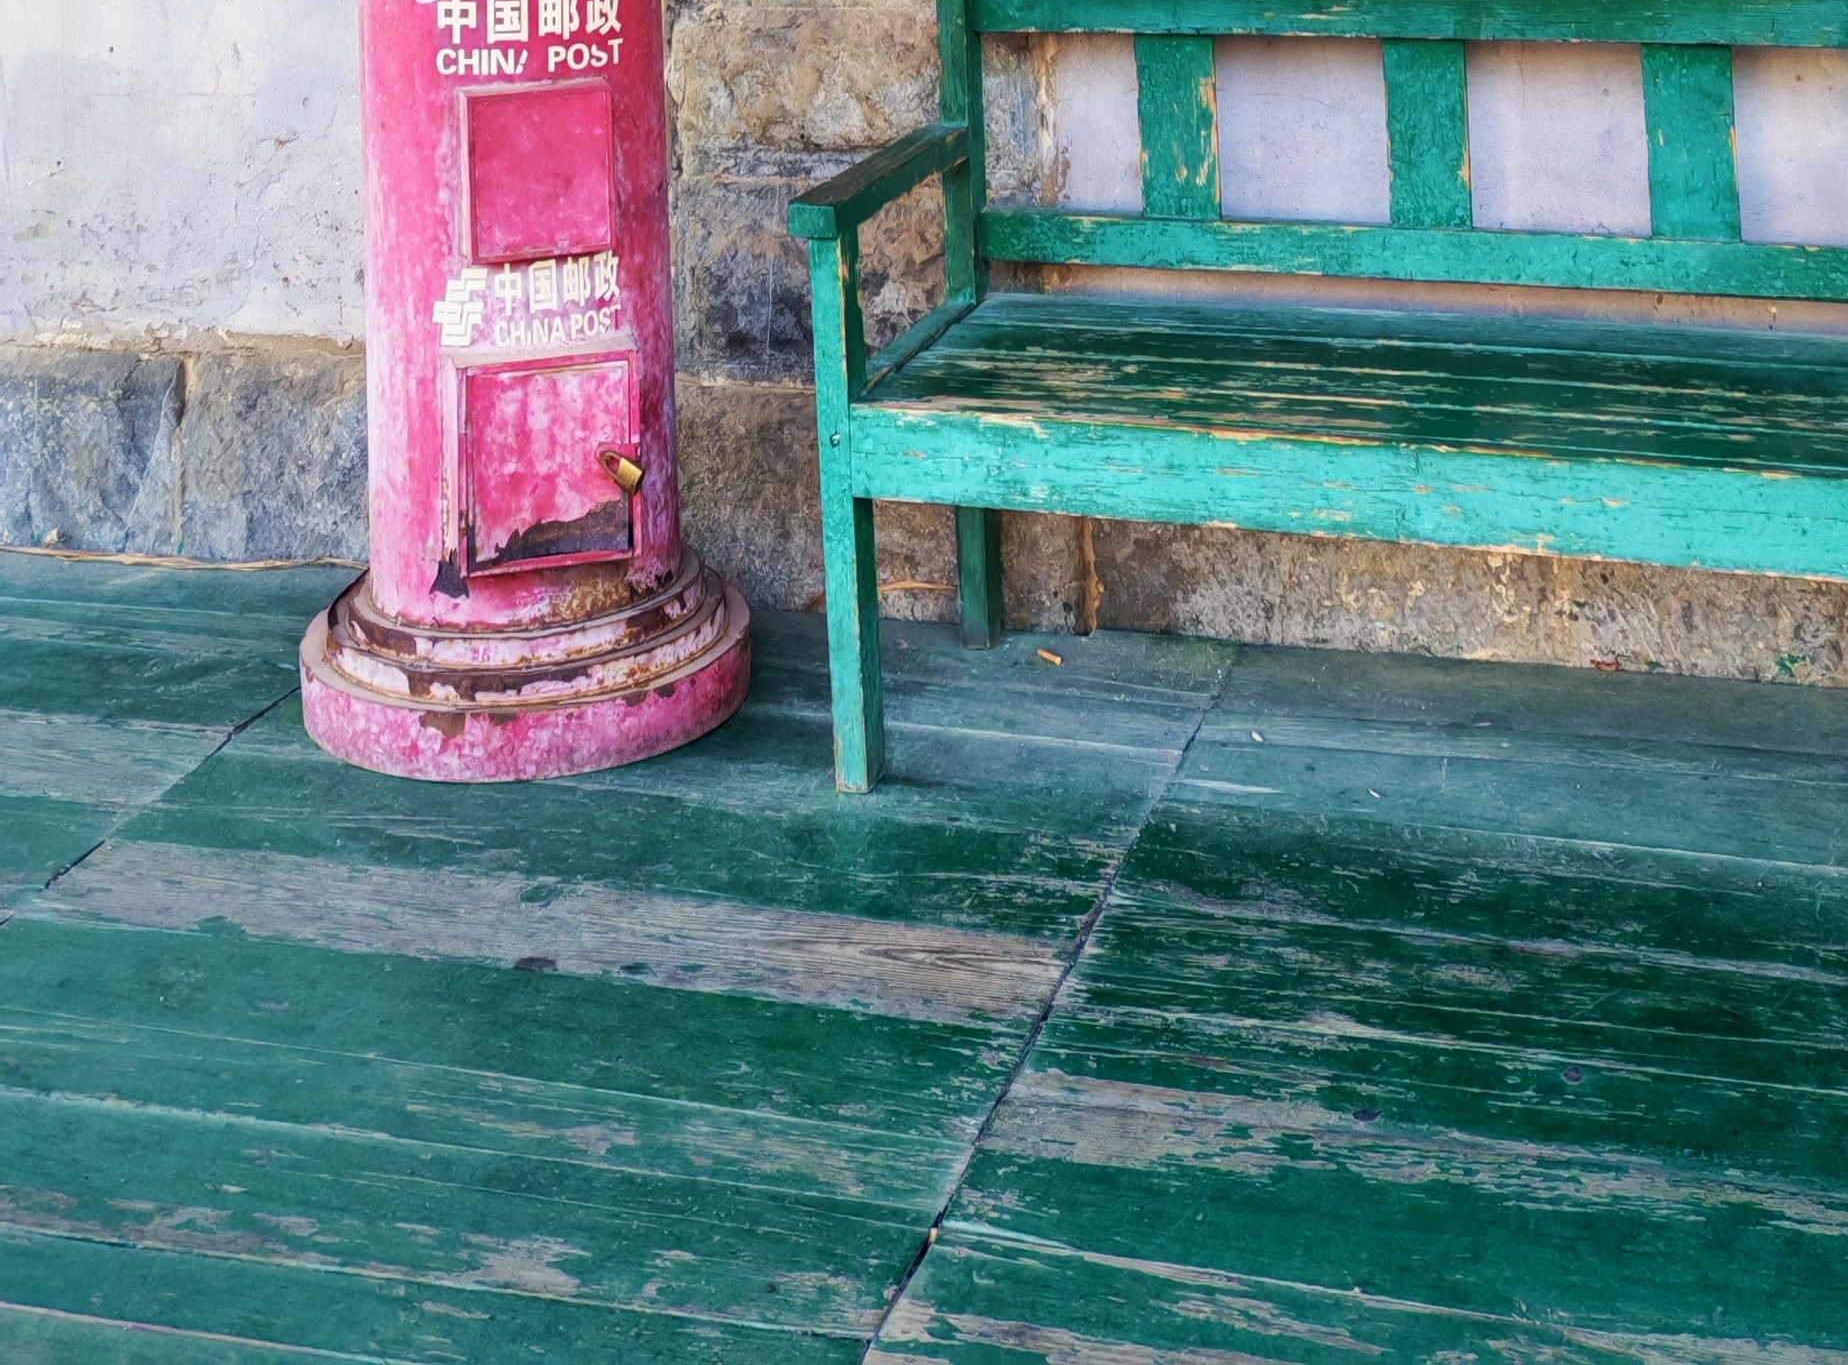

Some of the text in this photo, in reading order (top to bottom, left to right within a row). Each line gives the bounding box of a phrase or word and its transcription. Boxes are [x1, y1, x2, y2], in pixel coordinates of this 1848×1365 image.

[548, 38, 624, 72] POST
[495, 250, 620, 315] 中国邮政
